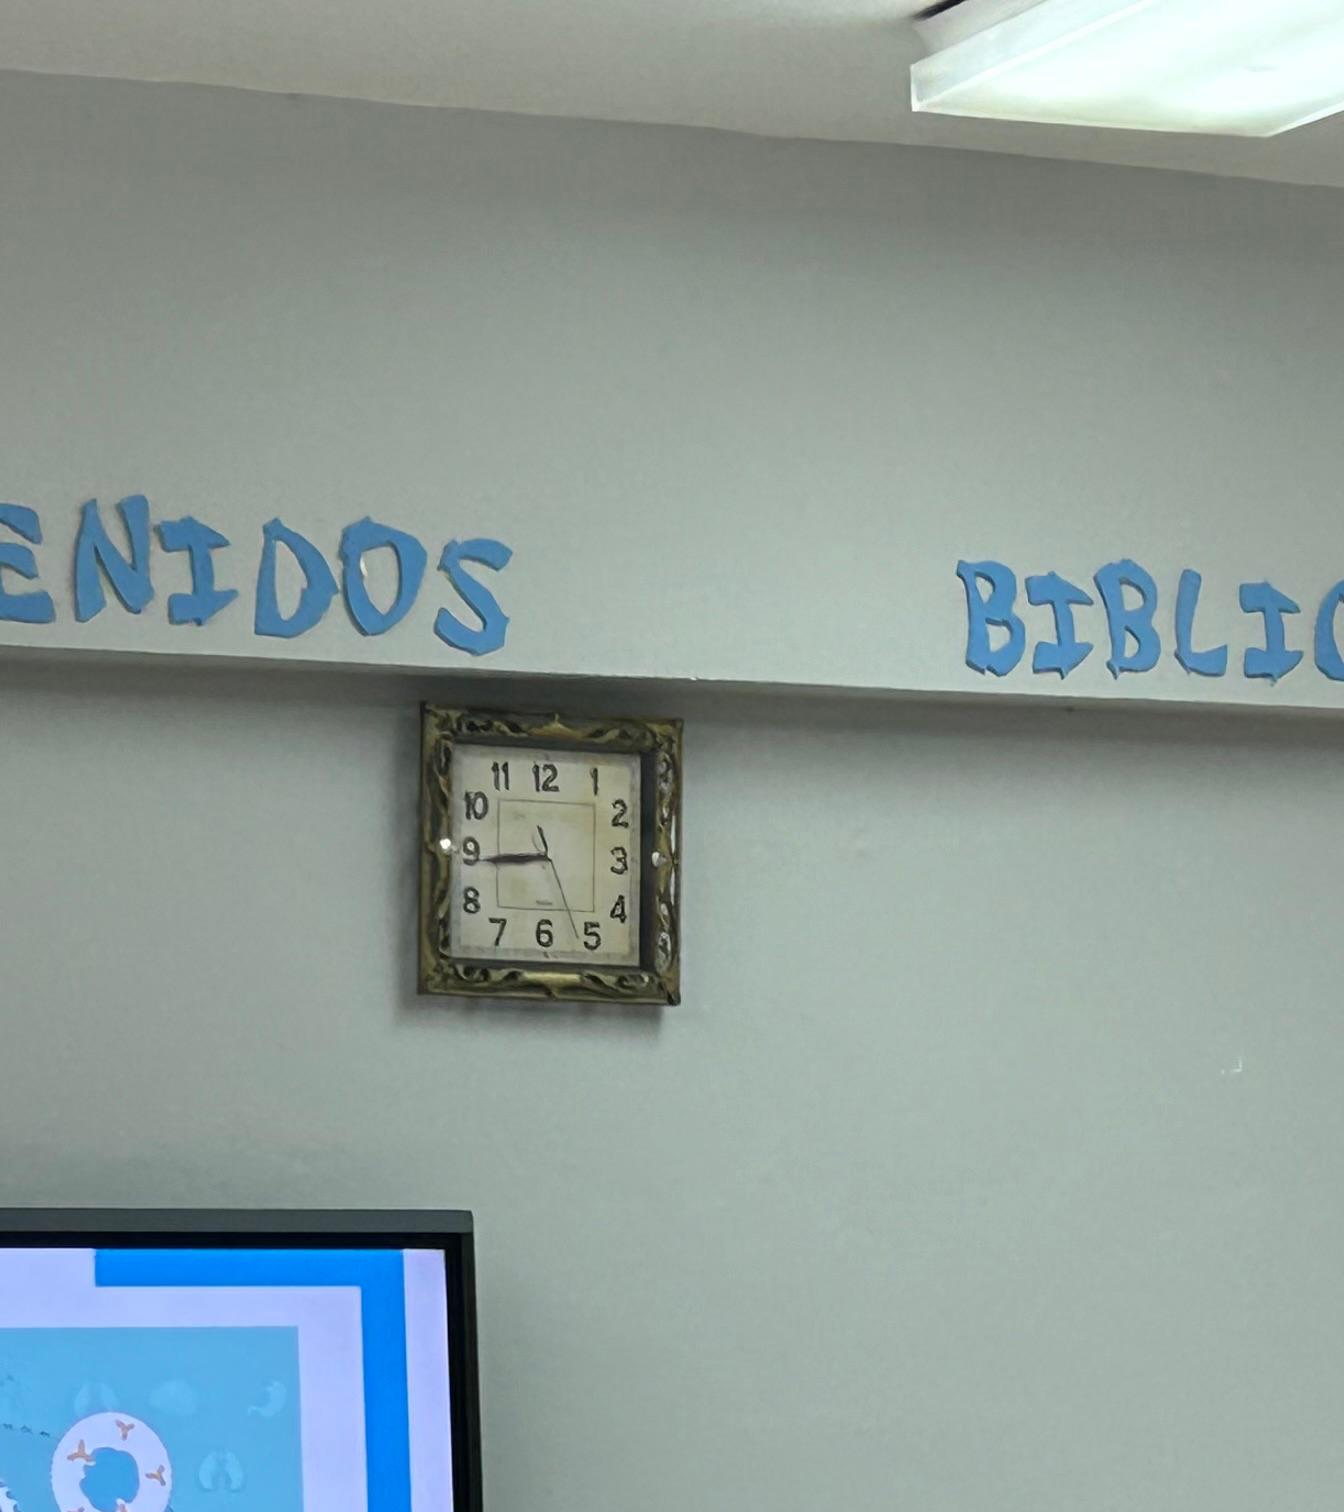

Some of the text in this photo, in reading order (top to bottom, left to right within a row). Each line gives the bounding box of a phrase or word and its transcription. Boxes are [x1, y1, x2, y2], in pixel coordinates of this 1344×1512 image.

[491, 762, 510, 791] 11
[532, 764, 560, 793] 12
[590, 768, 599, 796] 1
[463, 791, 489, 821] 10
[610, 799, 629, 828] 2
[462, 837, 481, 866] 9
[610, 846, 628, 875] 3
[462, 886, 481, 914] 8
[610, 895, 627, 924] 4
[488, 918, 507, 947] 7
[535, 919, 554, 948] 6
[583, 921, 602, 950] 5
